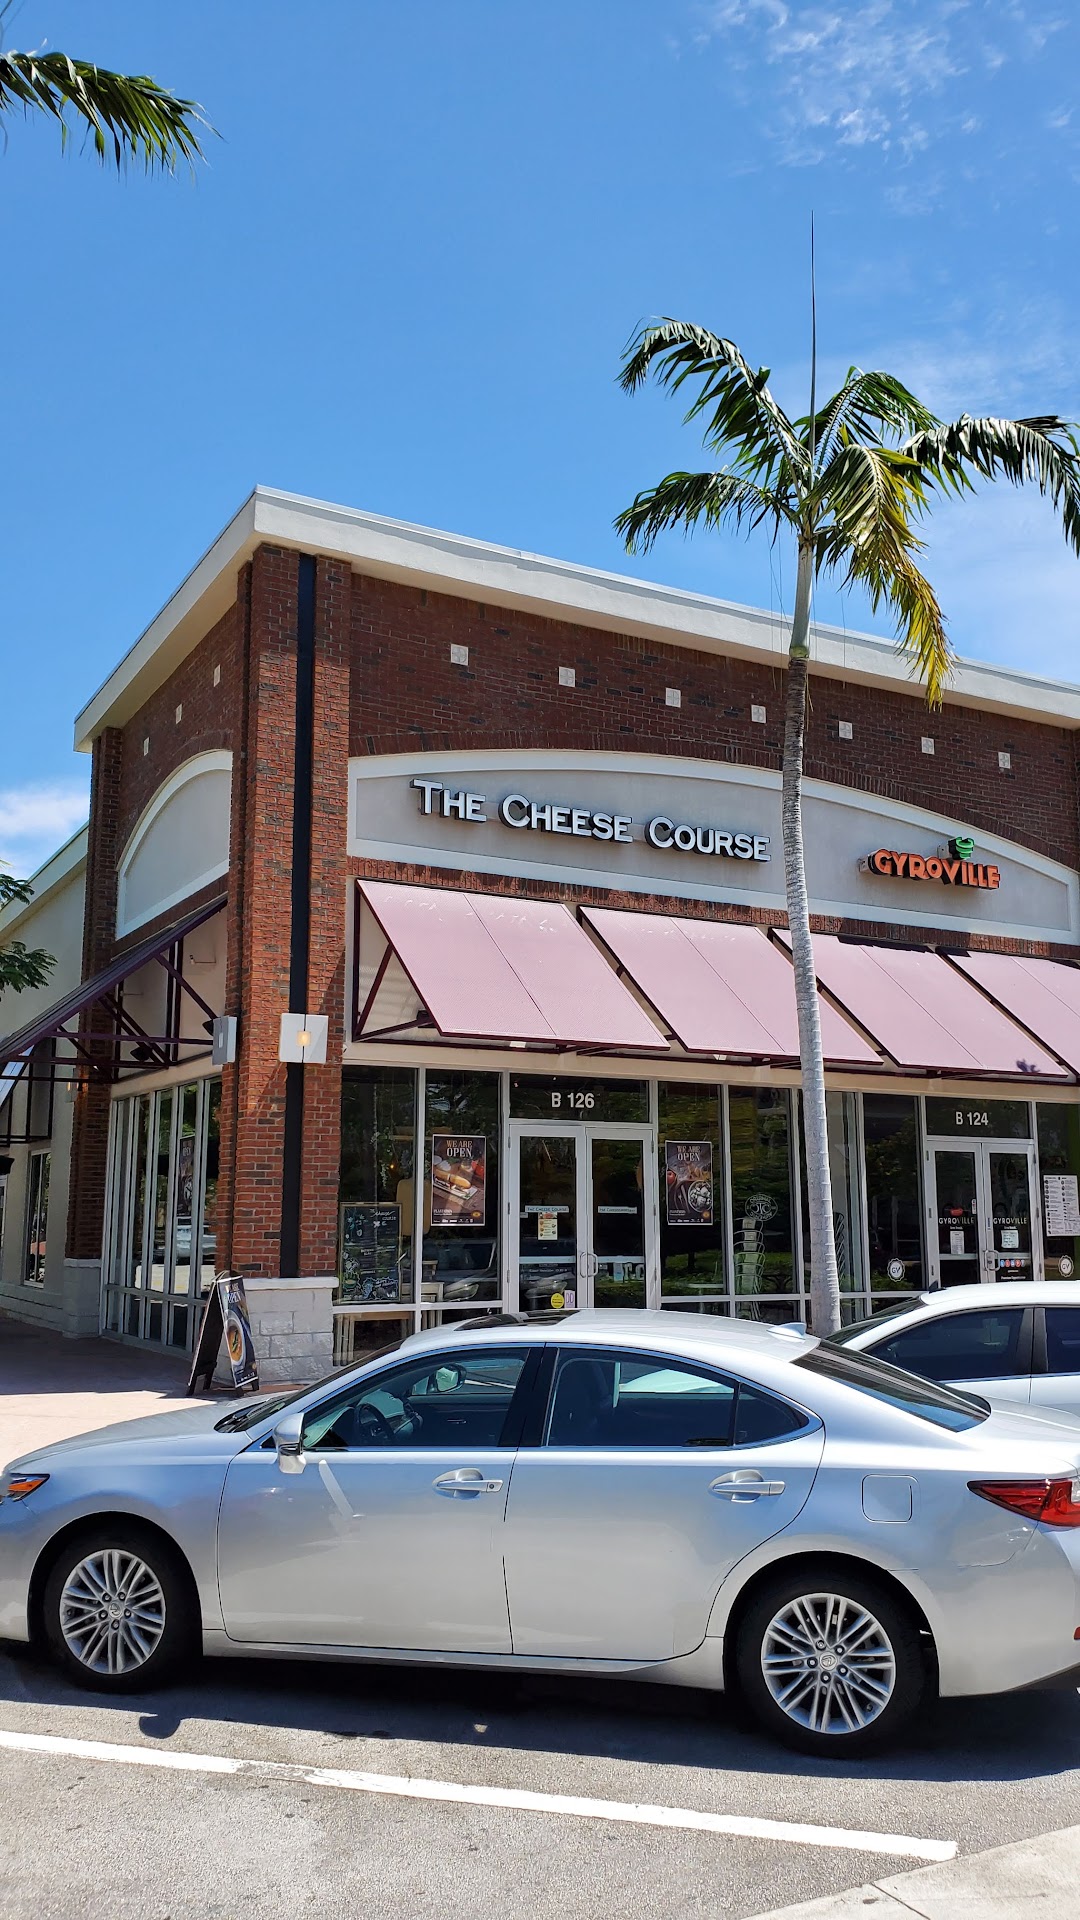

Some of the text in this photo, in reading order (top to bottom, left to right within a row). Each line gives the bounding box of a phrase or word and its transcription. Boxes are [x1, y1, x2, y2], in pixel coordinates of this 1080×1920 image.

[410, 779, 771, 862] THE CHEESE COURSE
[868, 849, 1000, 890] GYROVILLE
[551, 1092, 595, 1109] B 126
[955, 1111, 989, 1126] B 124
[446, 1140, 473, 1148] WE ARE
[446, 1147, 473, 1158] OPEN
[677, 1152, 700, 1161] OPEN
[938, 1217, 975, 1225] GYROVILLE
[993, 1217, 1027, 1225] GYROVILLE
